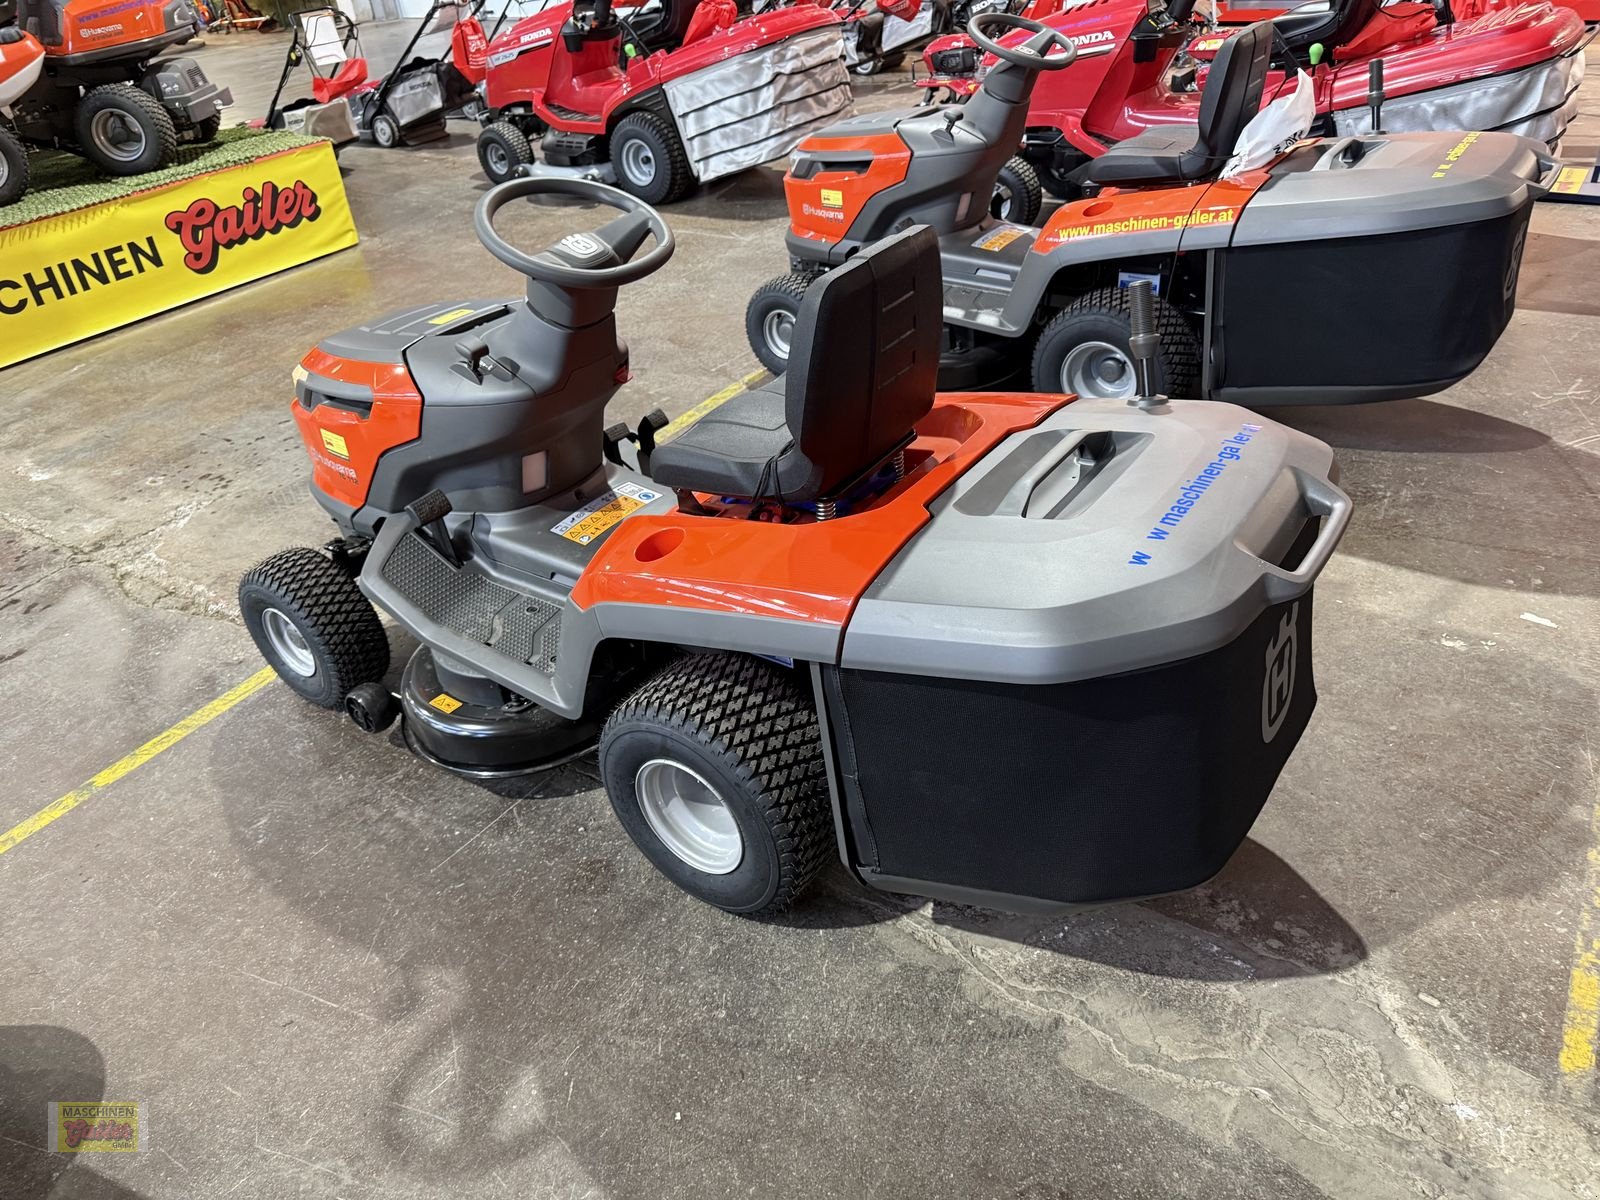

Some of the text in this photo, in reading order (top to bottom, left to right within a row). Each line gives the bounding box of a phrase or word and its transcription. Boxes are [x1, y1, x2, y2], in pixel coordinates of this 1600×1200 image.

[520, 28, 553, 43] HONDA
[1055, 30, 1115, 49] ONDA
[1059, 208, 1234, 240] www.maschinen-gailer.at
[0, 181, 320, 315] CHINEN Gailer
